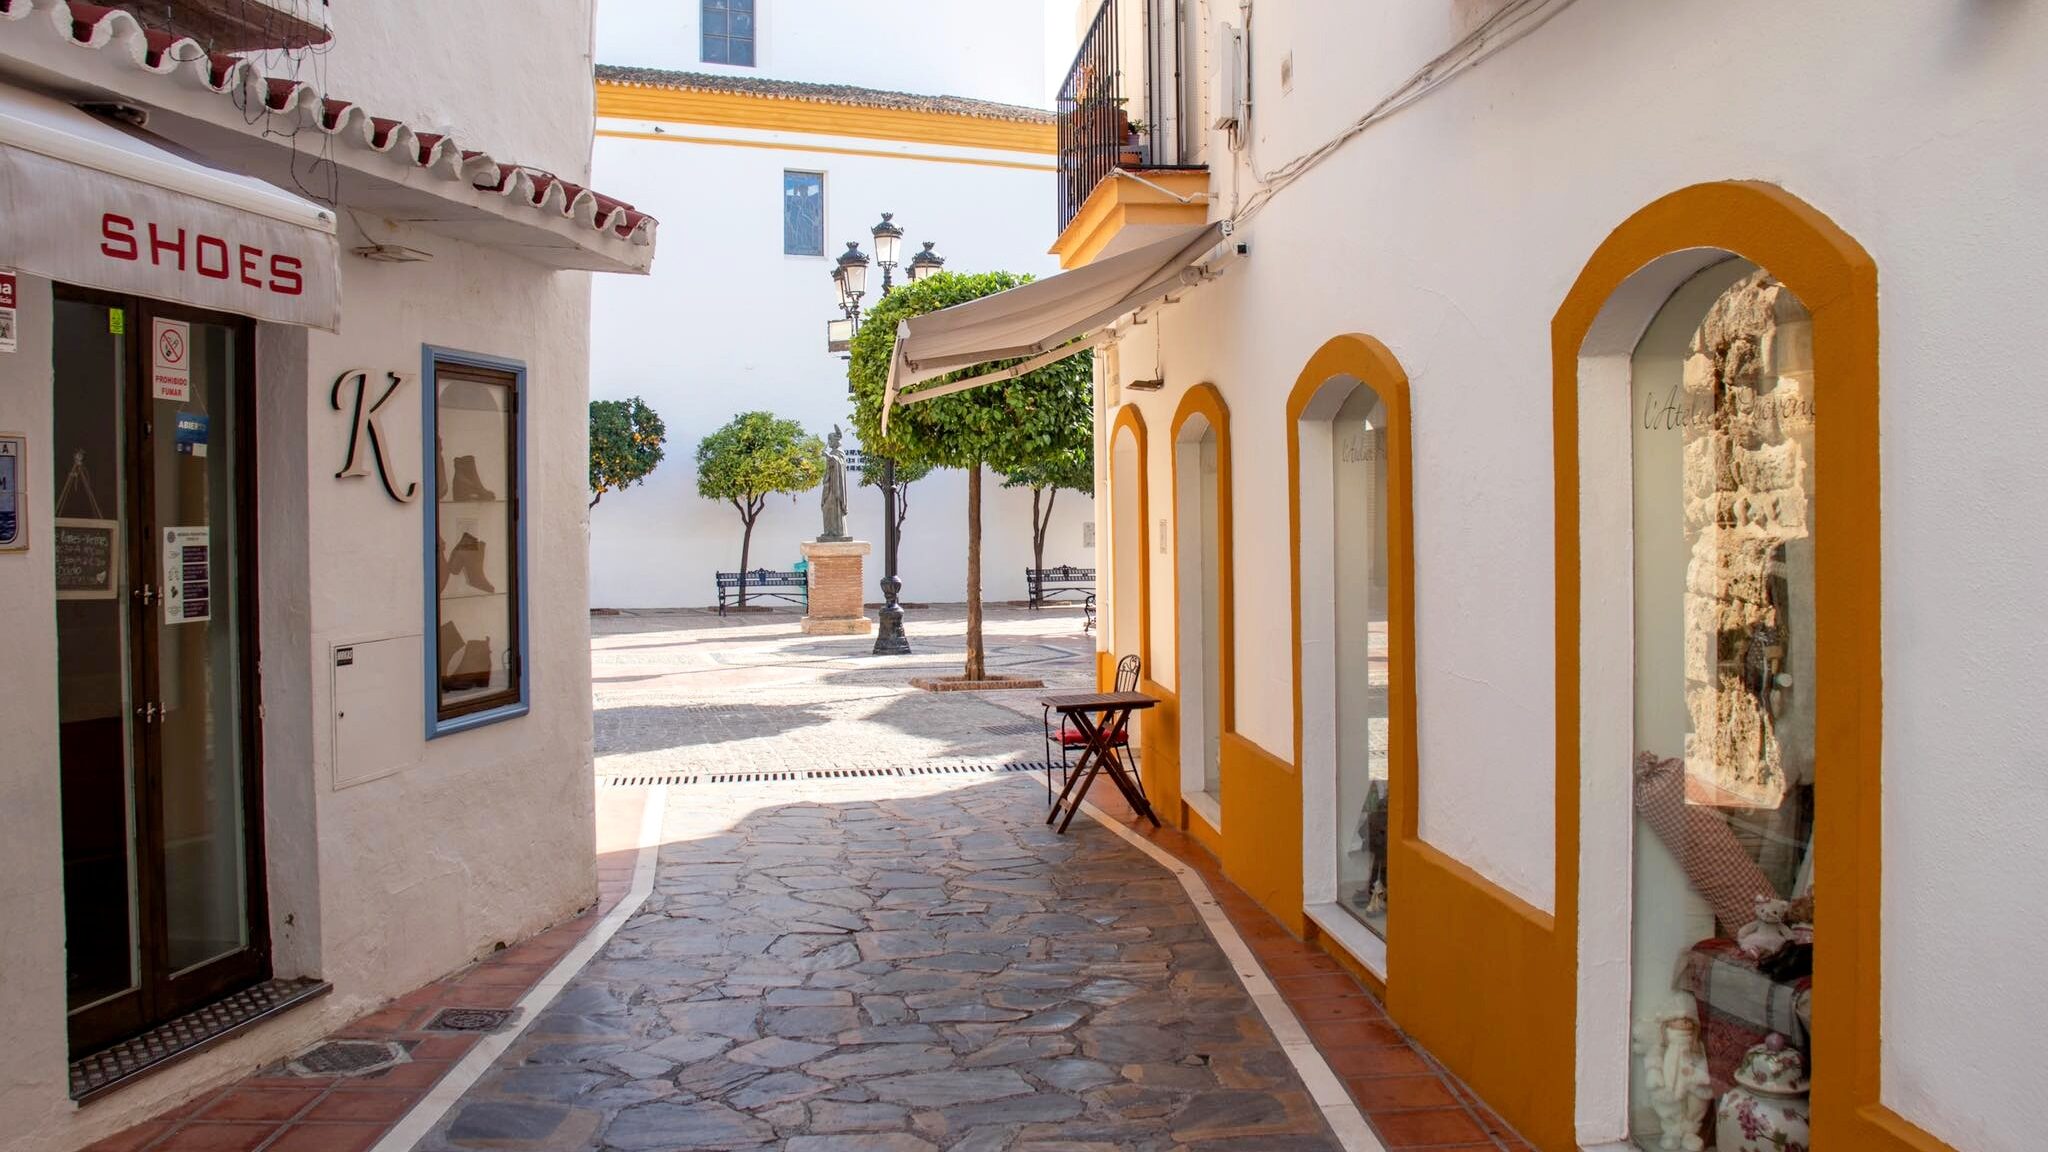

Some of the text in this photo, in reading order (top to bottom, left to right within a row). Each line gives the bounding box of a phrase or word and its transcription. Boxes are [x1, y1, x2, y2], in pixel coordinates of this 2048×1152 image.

[101, 213, 303, 295] SHOES
[155, 375, 188, 386] PROHIBIDO
[161, 387, 183, 397] FUMAR
[332, 369, 418, 503] K
